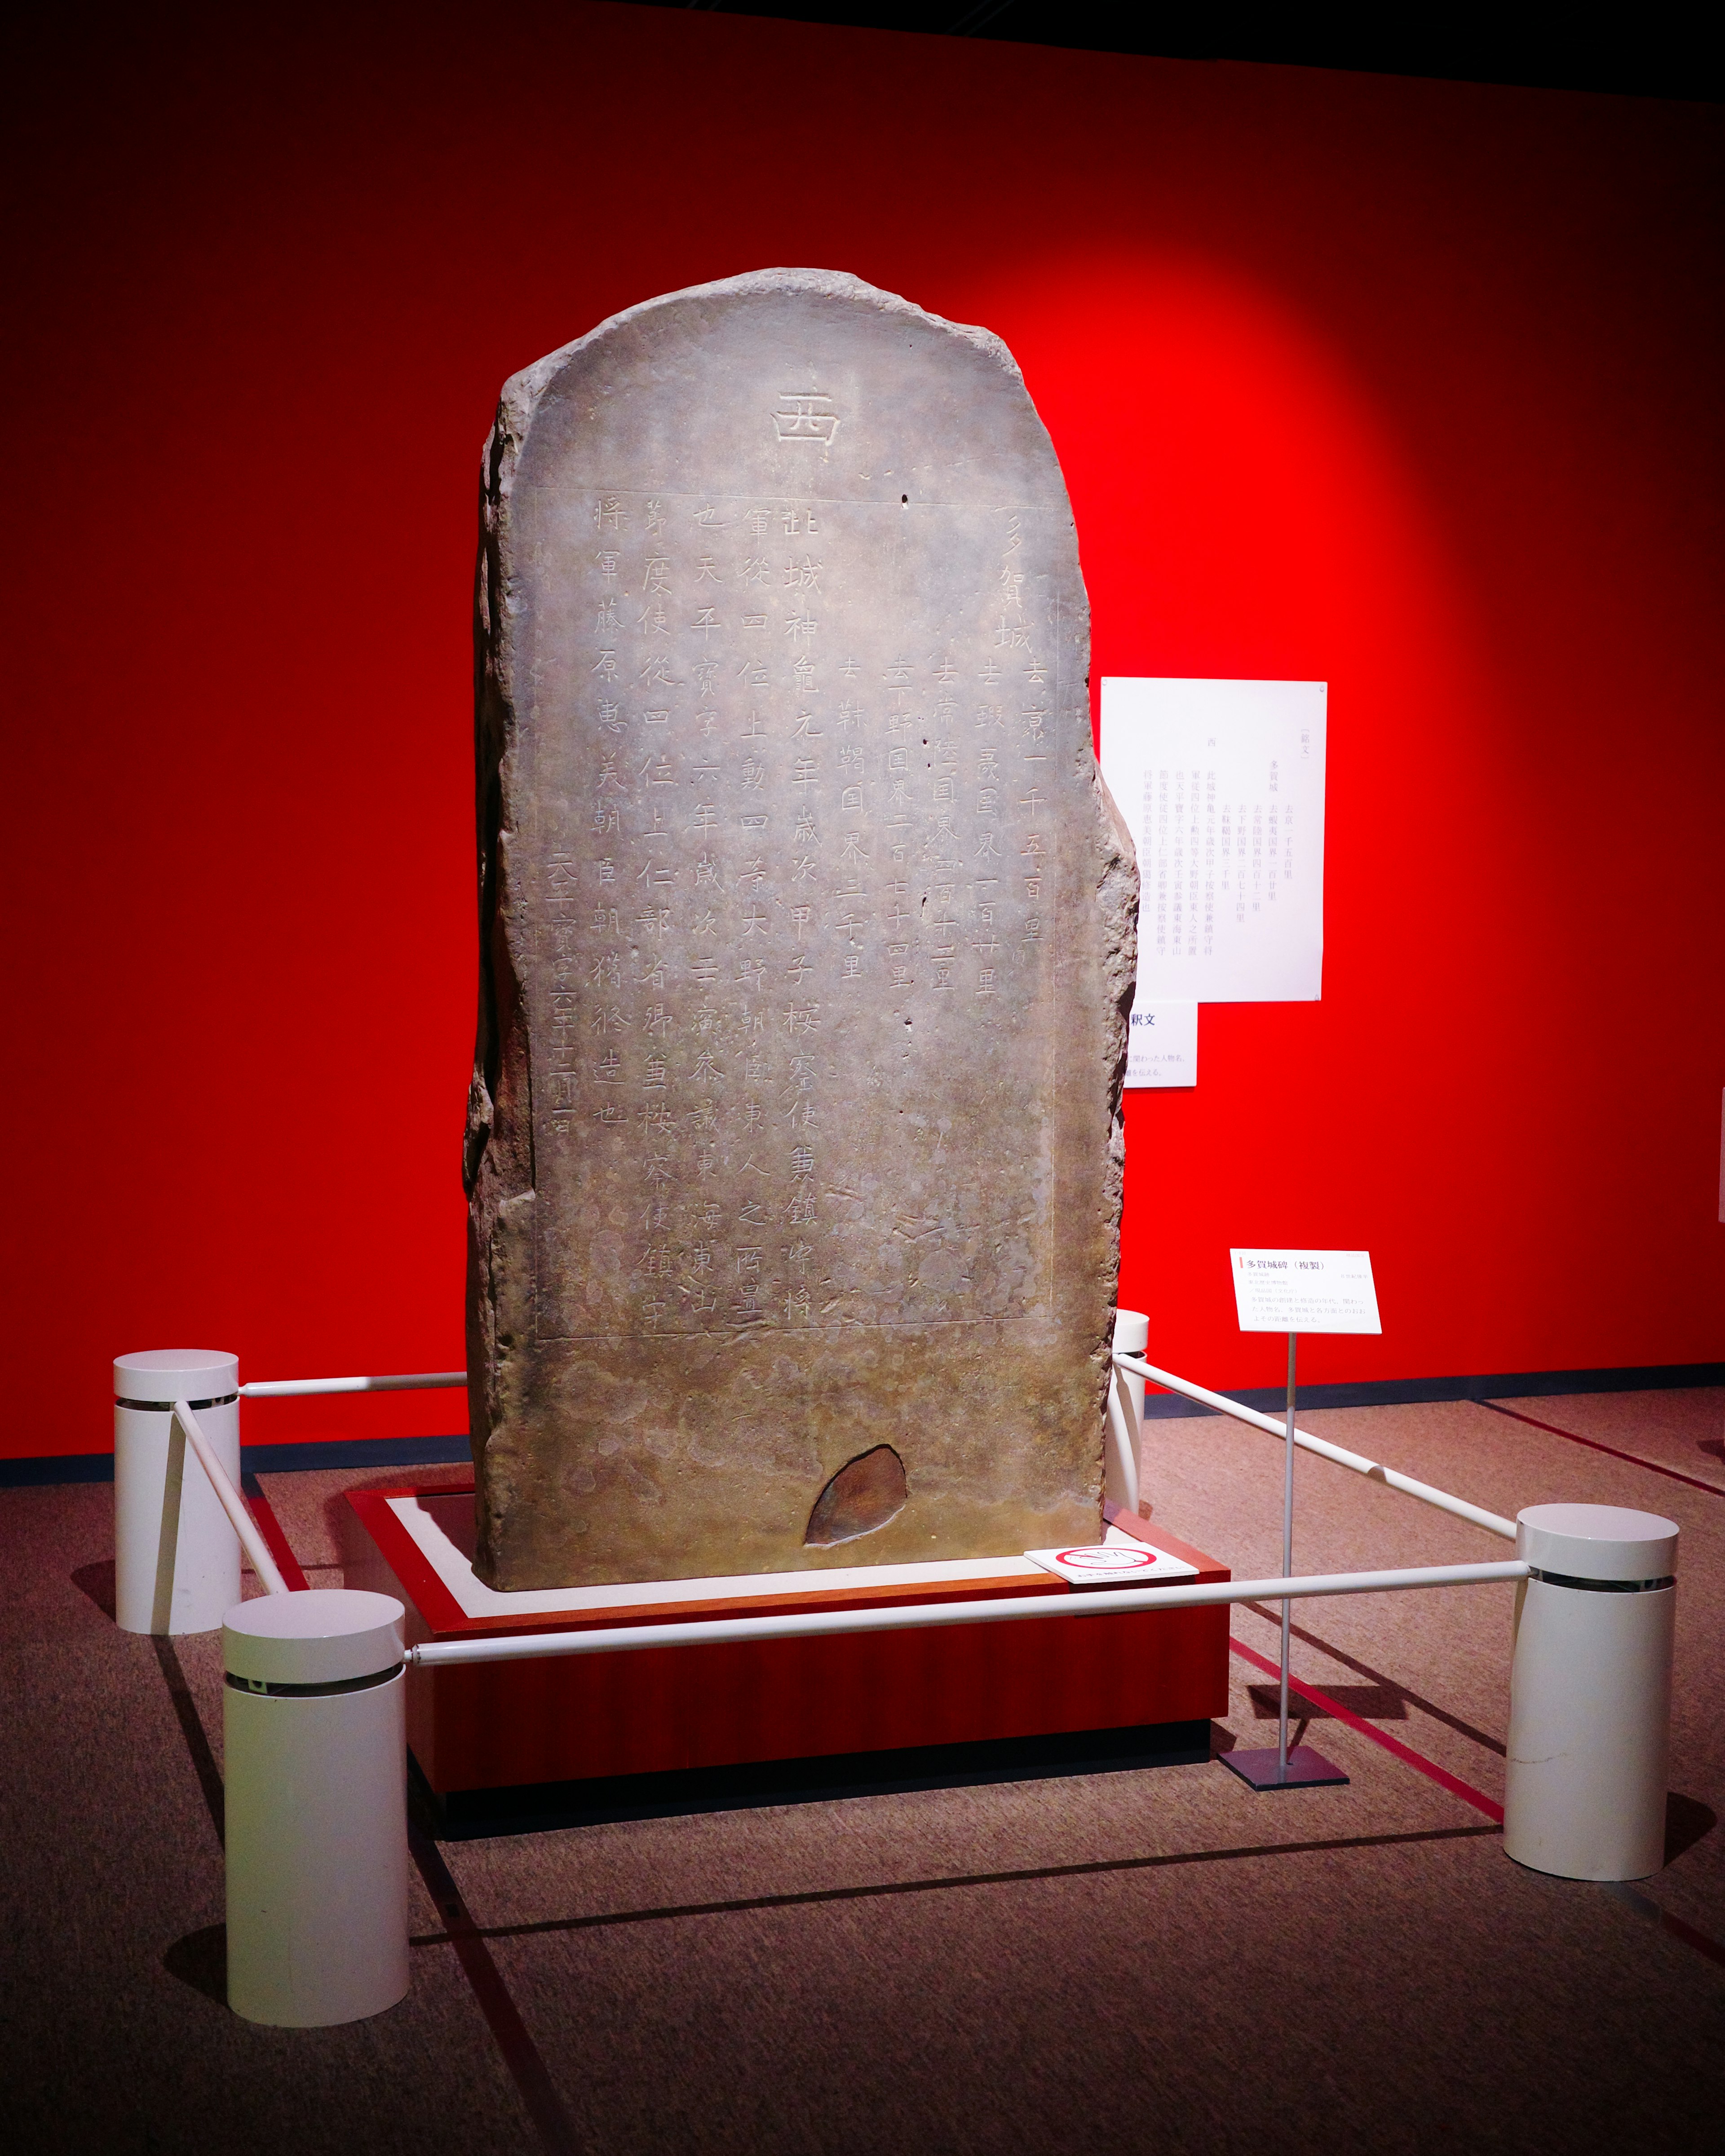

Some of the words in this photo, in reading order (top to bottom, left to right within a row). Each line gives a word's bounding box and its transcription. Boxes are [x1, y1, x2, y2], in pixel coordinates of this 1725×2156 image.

[770, 389, 841, 447] 西
[995, 514, 1034, 653] 多賀城
[1208, 738, 1216, 746] 西
[1269, 760, 1278, 792] 多賀城
[1236, 804, 1247, 922] 去下野国界二百七十四里
[1252, 804, 1262, 912] 去常陸国界四百十二里
[1284, 804, 1293, 879] 去京一千五百里
